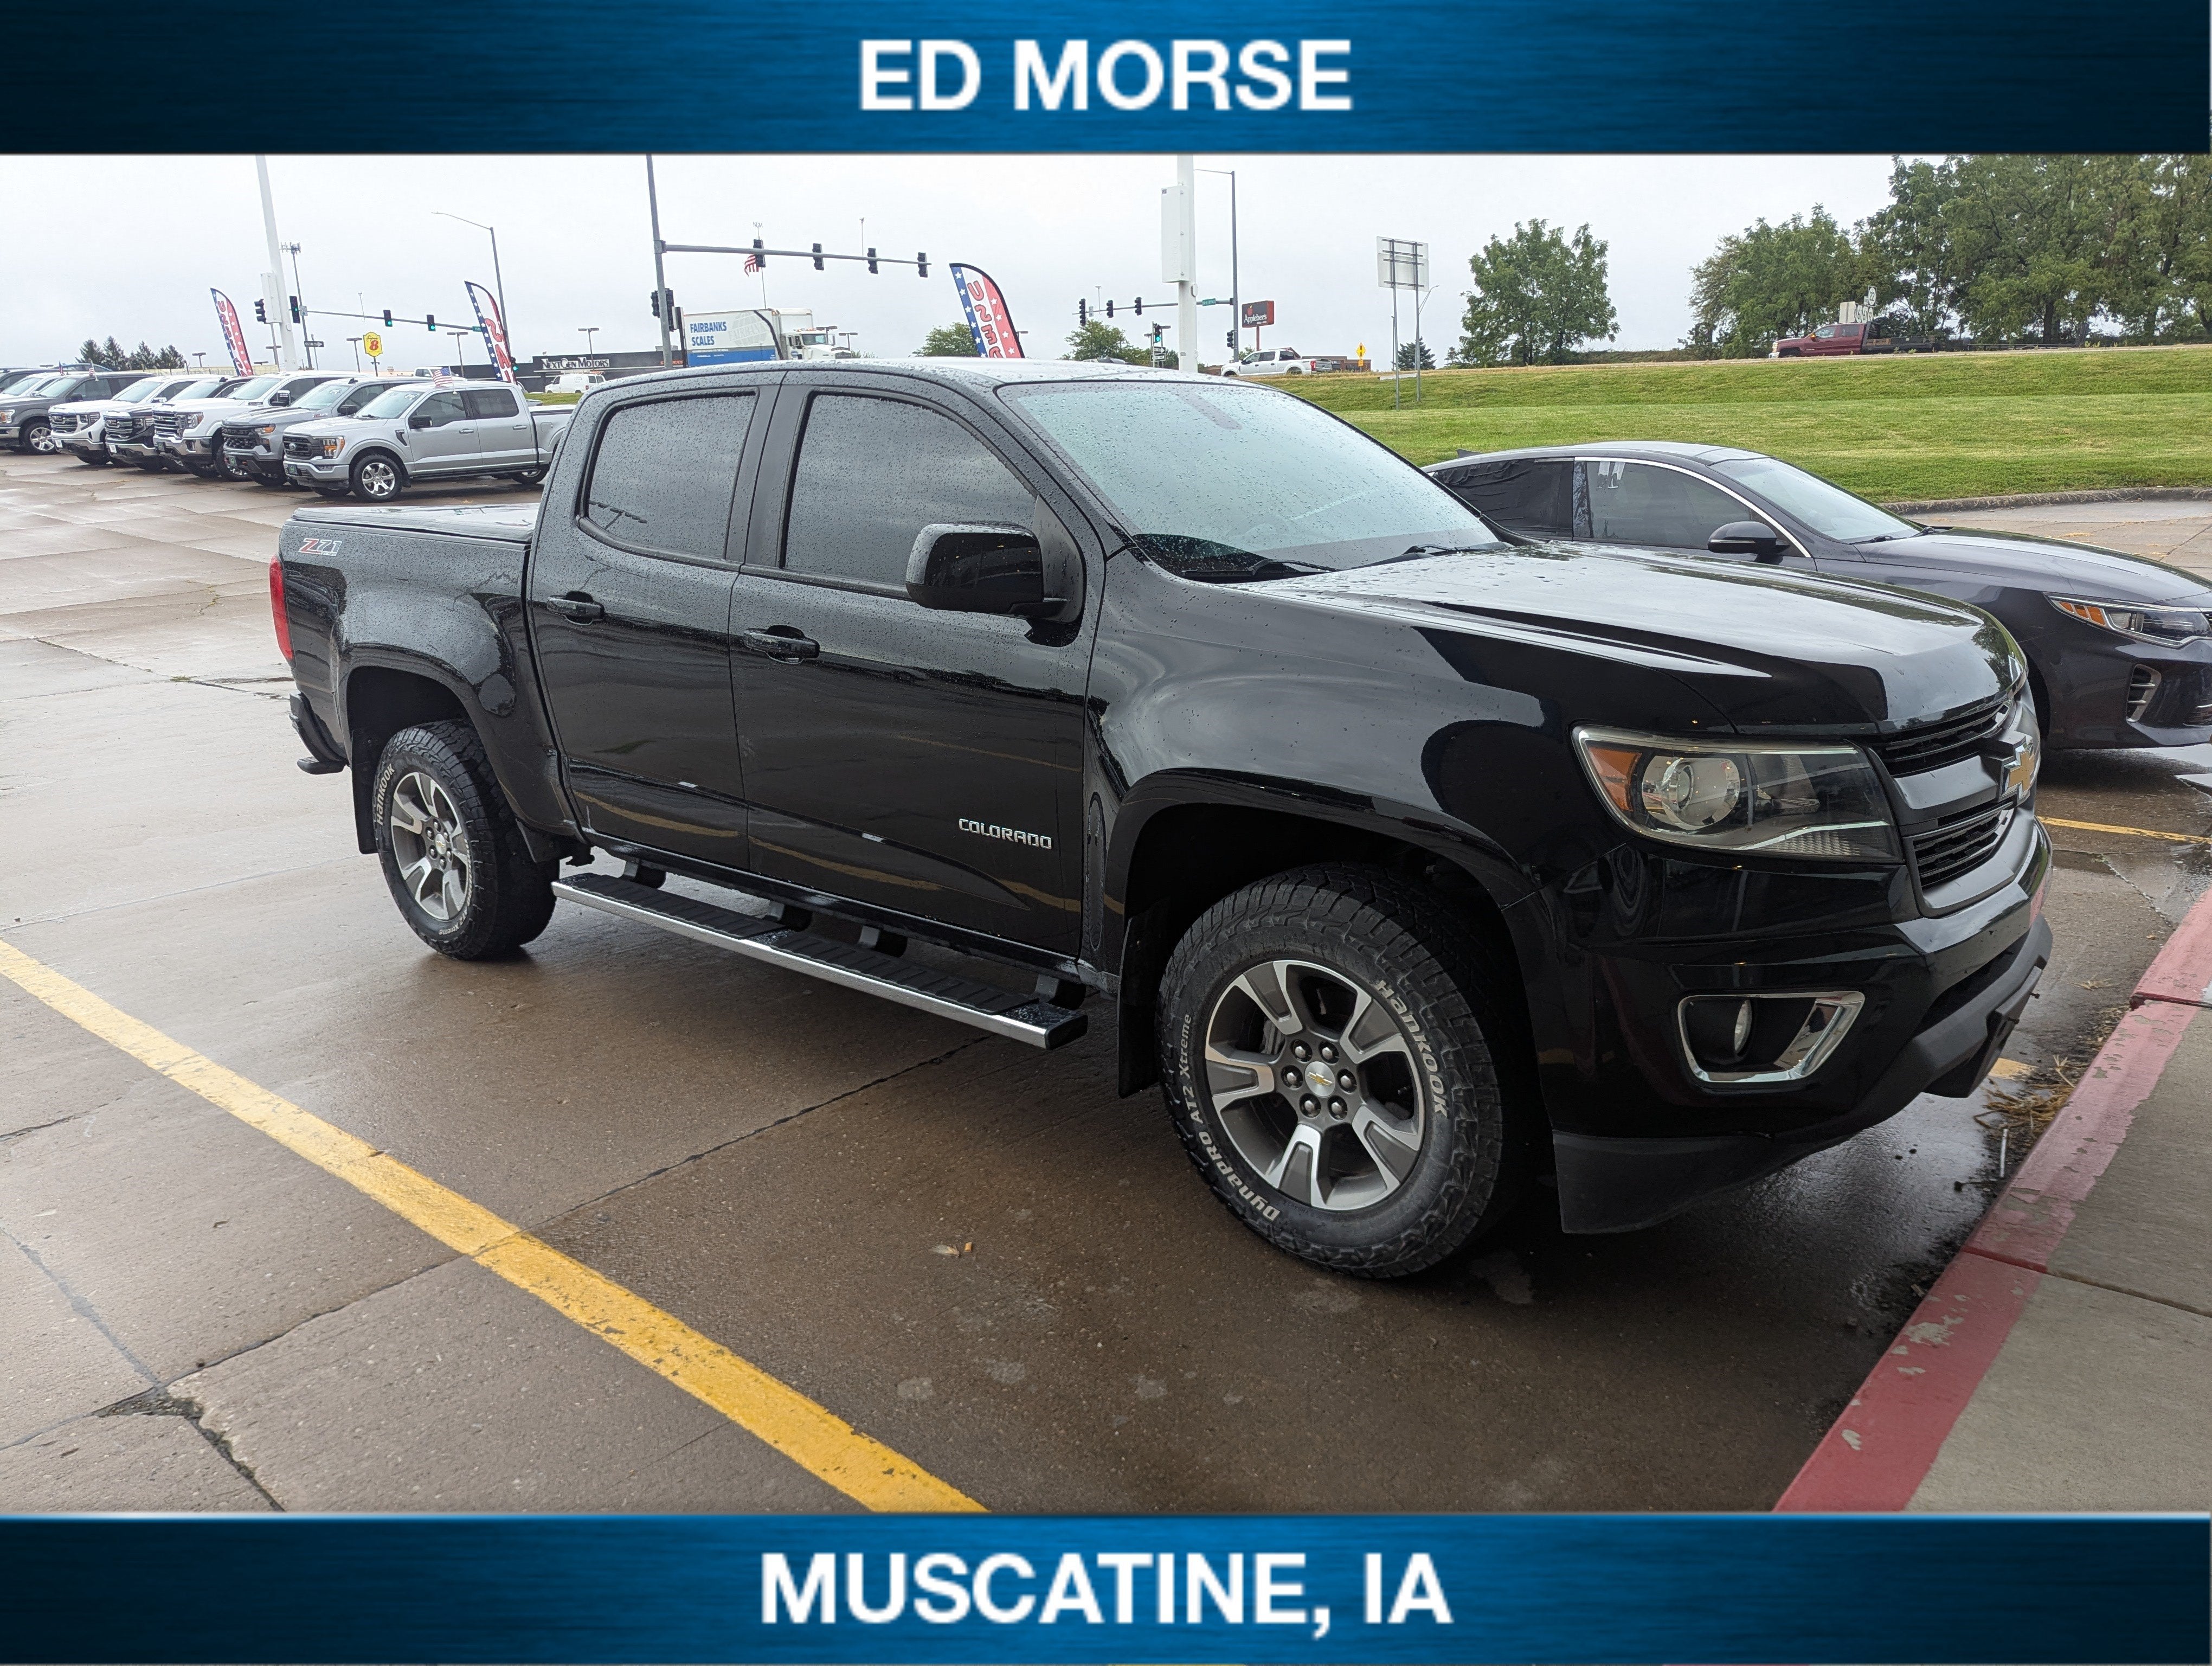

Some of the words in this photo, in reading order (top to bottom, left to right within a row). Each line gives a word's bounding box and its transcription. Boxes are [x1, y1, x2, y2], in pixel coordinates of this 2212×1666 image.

[690, 321, 727, 333] FAIRBANKS
[369, 339, 379, 351] 8
[692, 335, 715, 346] SCALES
[299, 538, 342, 556] Z71
[959, 818, 1052, 850] COLORADO
[1179, 1014, 1192, 1079] Xtreme
[1182, 1085, 1204, 1124] AT2
